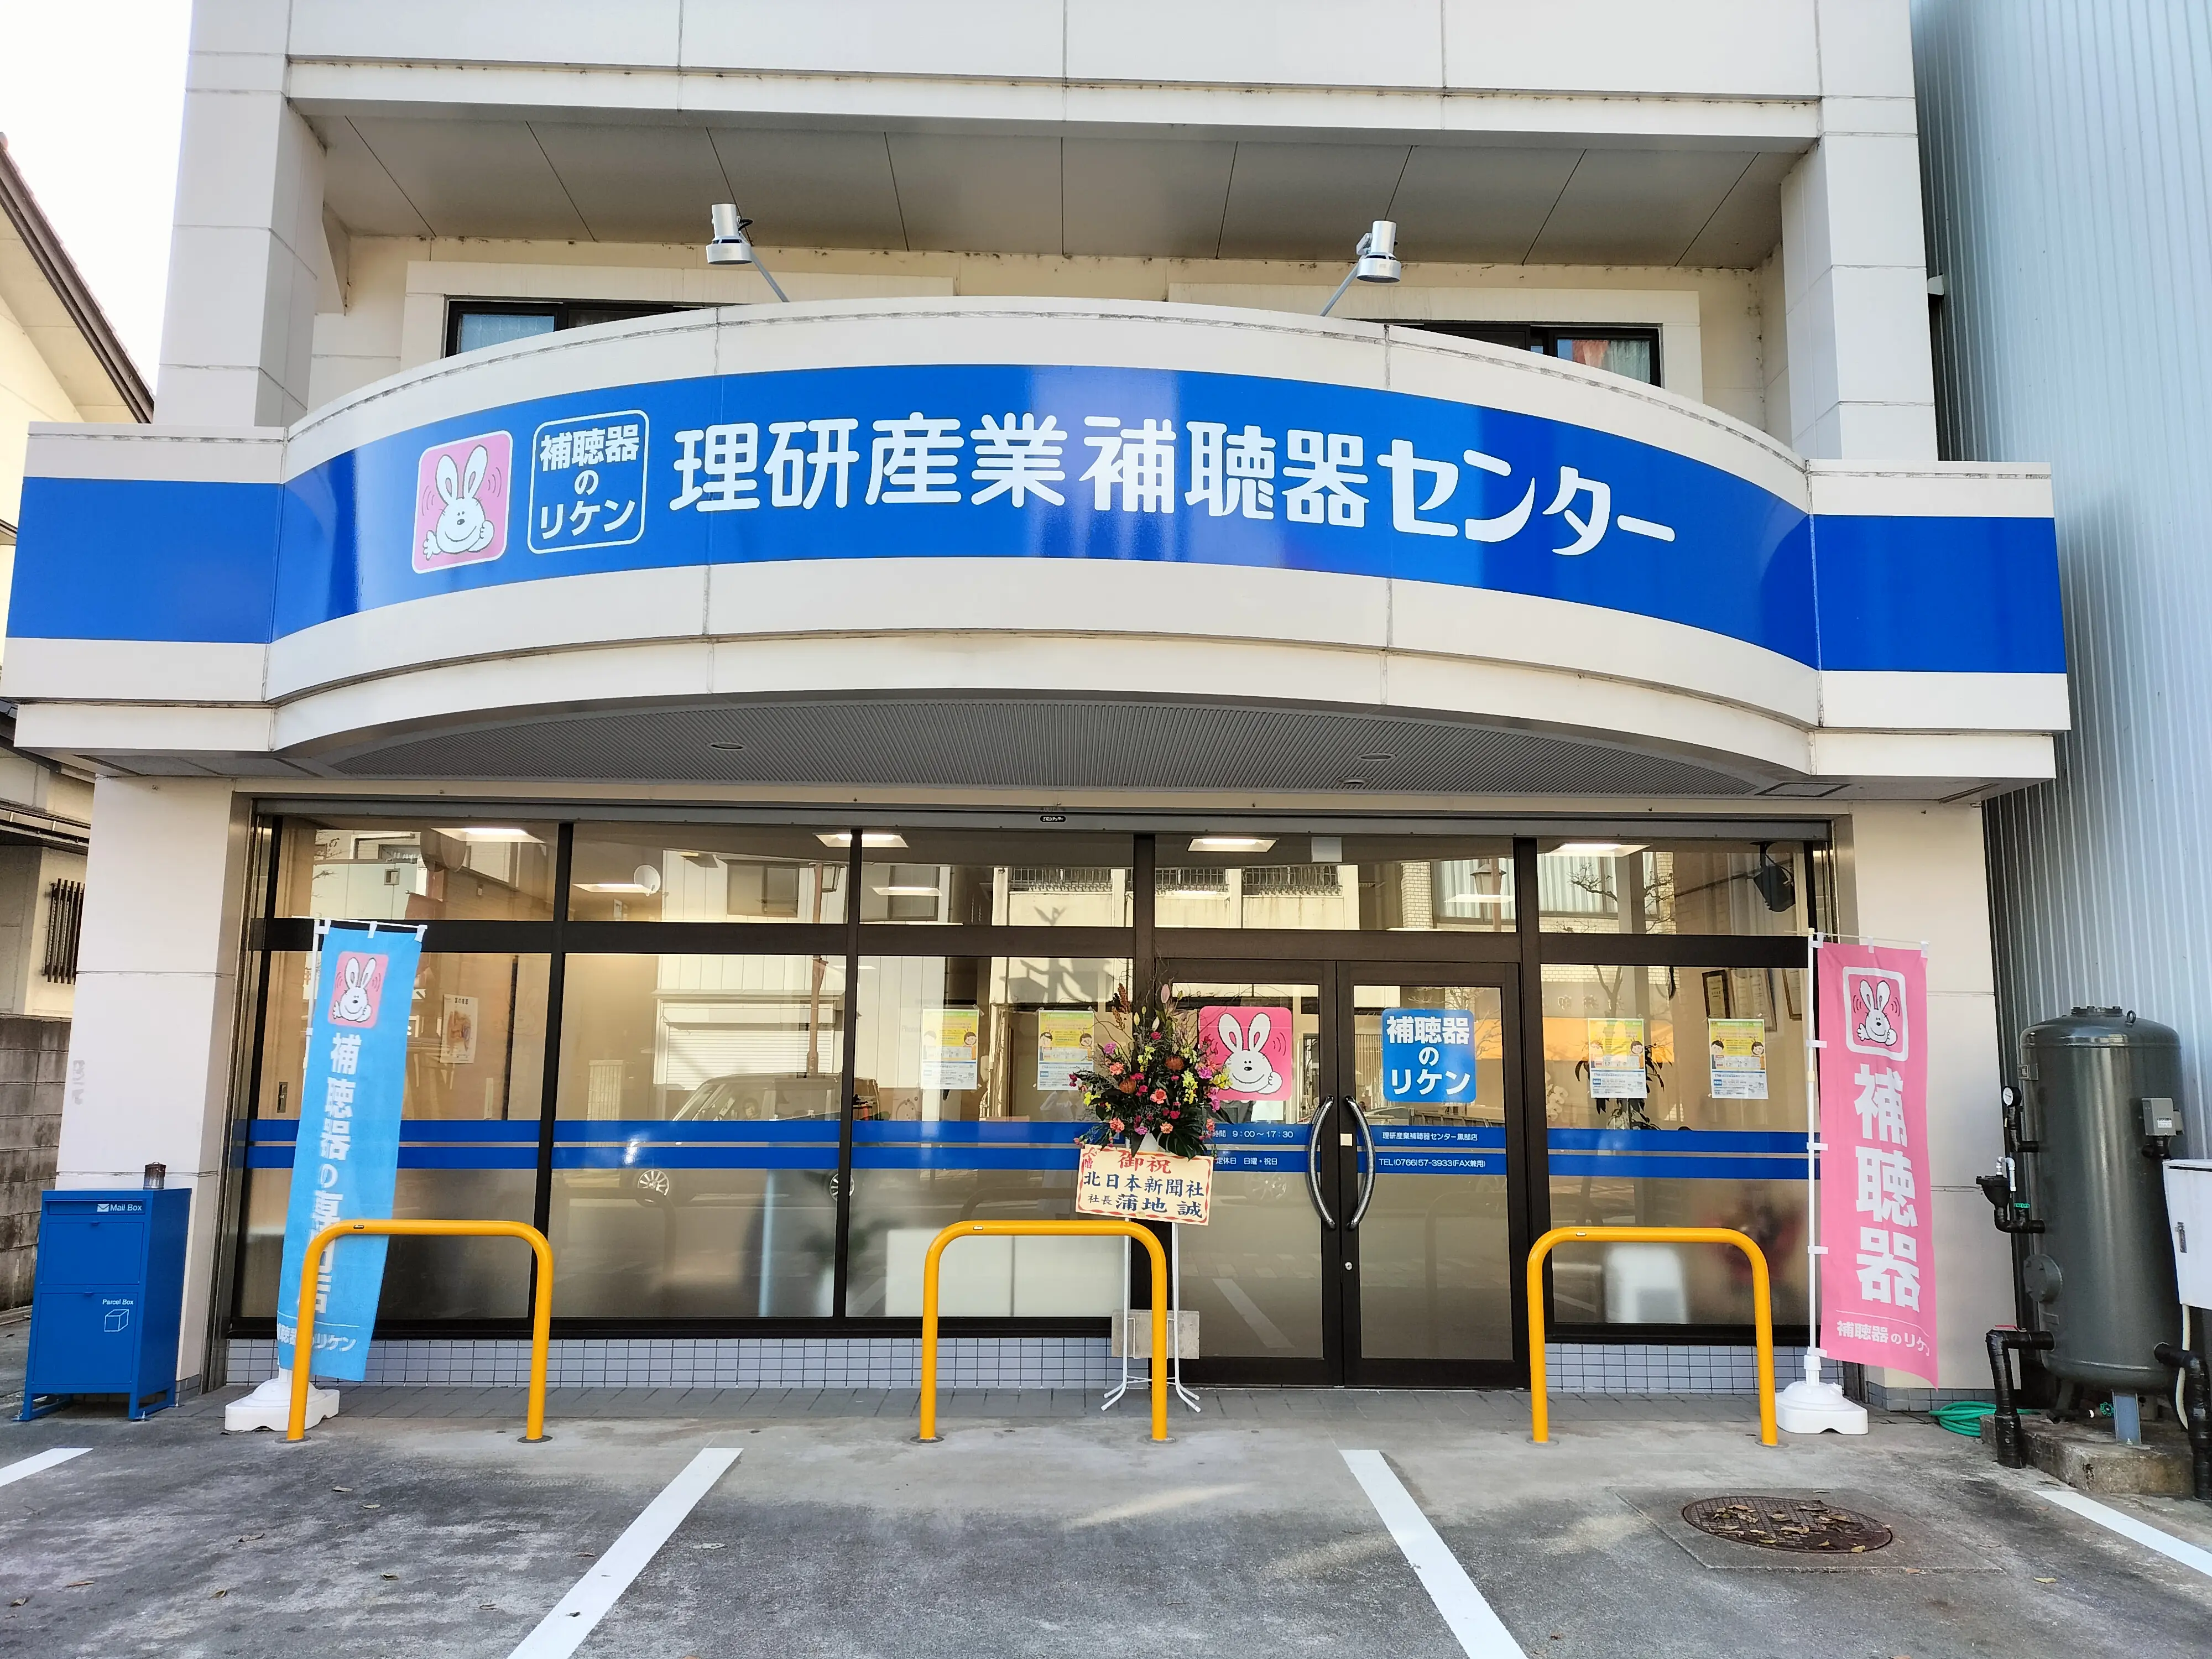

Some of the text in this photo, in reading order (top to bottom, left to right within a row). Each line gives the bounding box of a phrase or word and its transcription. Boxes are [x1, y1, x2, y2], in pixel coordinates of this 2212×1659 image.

[540, 424, 639, 472] 補聴器
[574, 469, 599, 495] の
[670, 411, 1676, 556] 理研産業補聴器センター
[540, 499, 635, 540] リケン
[1386, 1016, 1470, 1045] 補聴器
[1418, 1046, 1439, 1066] の
[1392, 1068, 1470, 1095] リケン
[1083, 1171, 1204, 1198] 北日本新聞社
[1854, 1063, 1921, 1313] 補聴器
[1176, 1201, 1203, 1219] 誠
